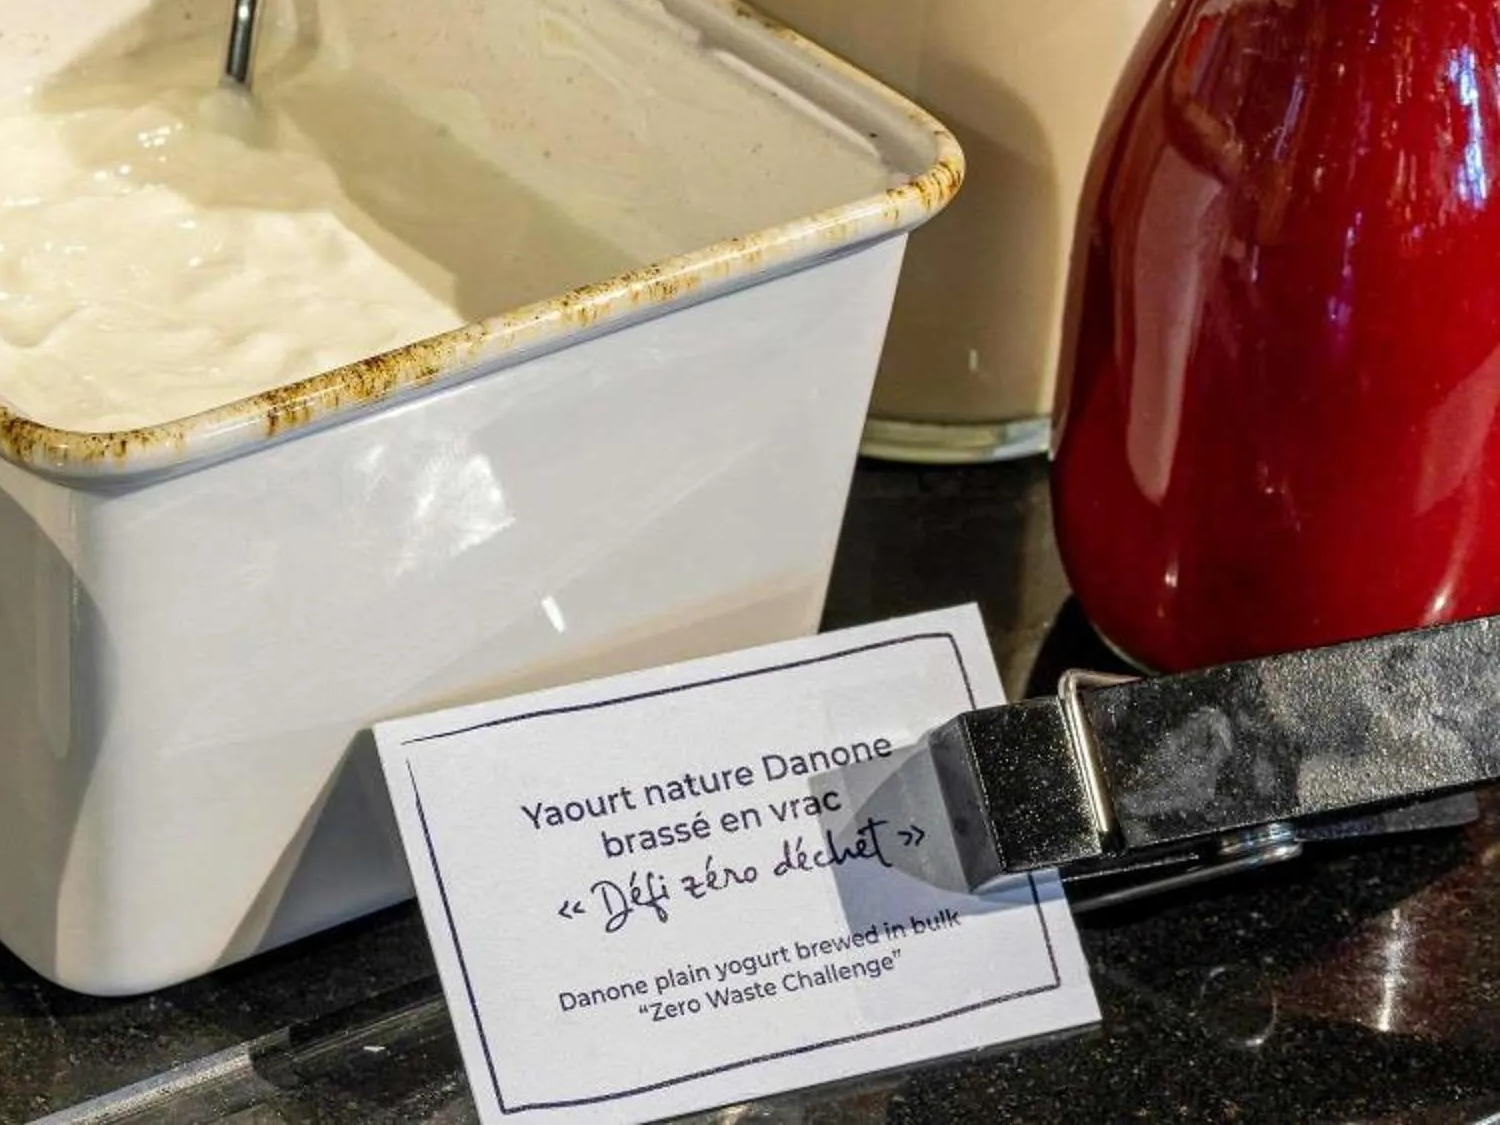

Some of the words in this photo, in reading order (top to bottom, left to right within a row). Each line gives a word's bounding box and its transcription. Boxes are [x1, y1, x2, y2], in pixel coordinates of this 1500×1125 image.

[521, 786, 637, 830] Yaourt
[644, 765, 755, 806] nature
[761, 737, 892, 783] Danone
[601, 810, 711, 859] brassé
[720, 807, 762, 833] en
[769, 790, 842, 823] vrac
[590, 870, 671, 934] Défi
[681, 854, 759, 900] zéro
[773, 817, 893, 877] déchet
[559, 978, 649, 1012] Danone
[654, 964, 711, 996] plain
[714, 945, 790, 982] yogurt
[794, 924, 880, 961] brewed
[884, 921, 905, 941] in
[909, 908, 962, 935] bulk
[705, 980, 777, 1010] Waste
